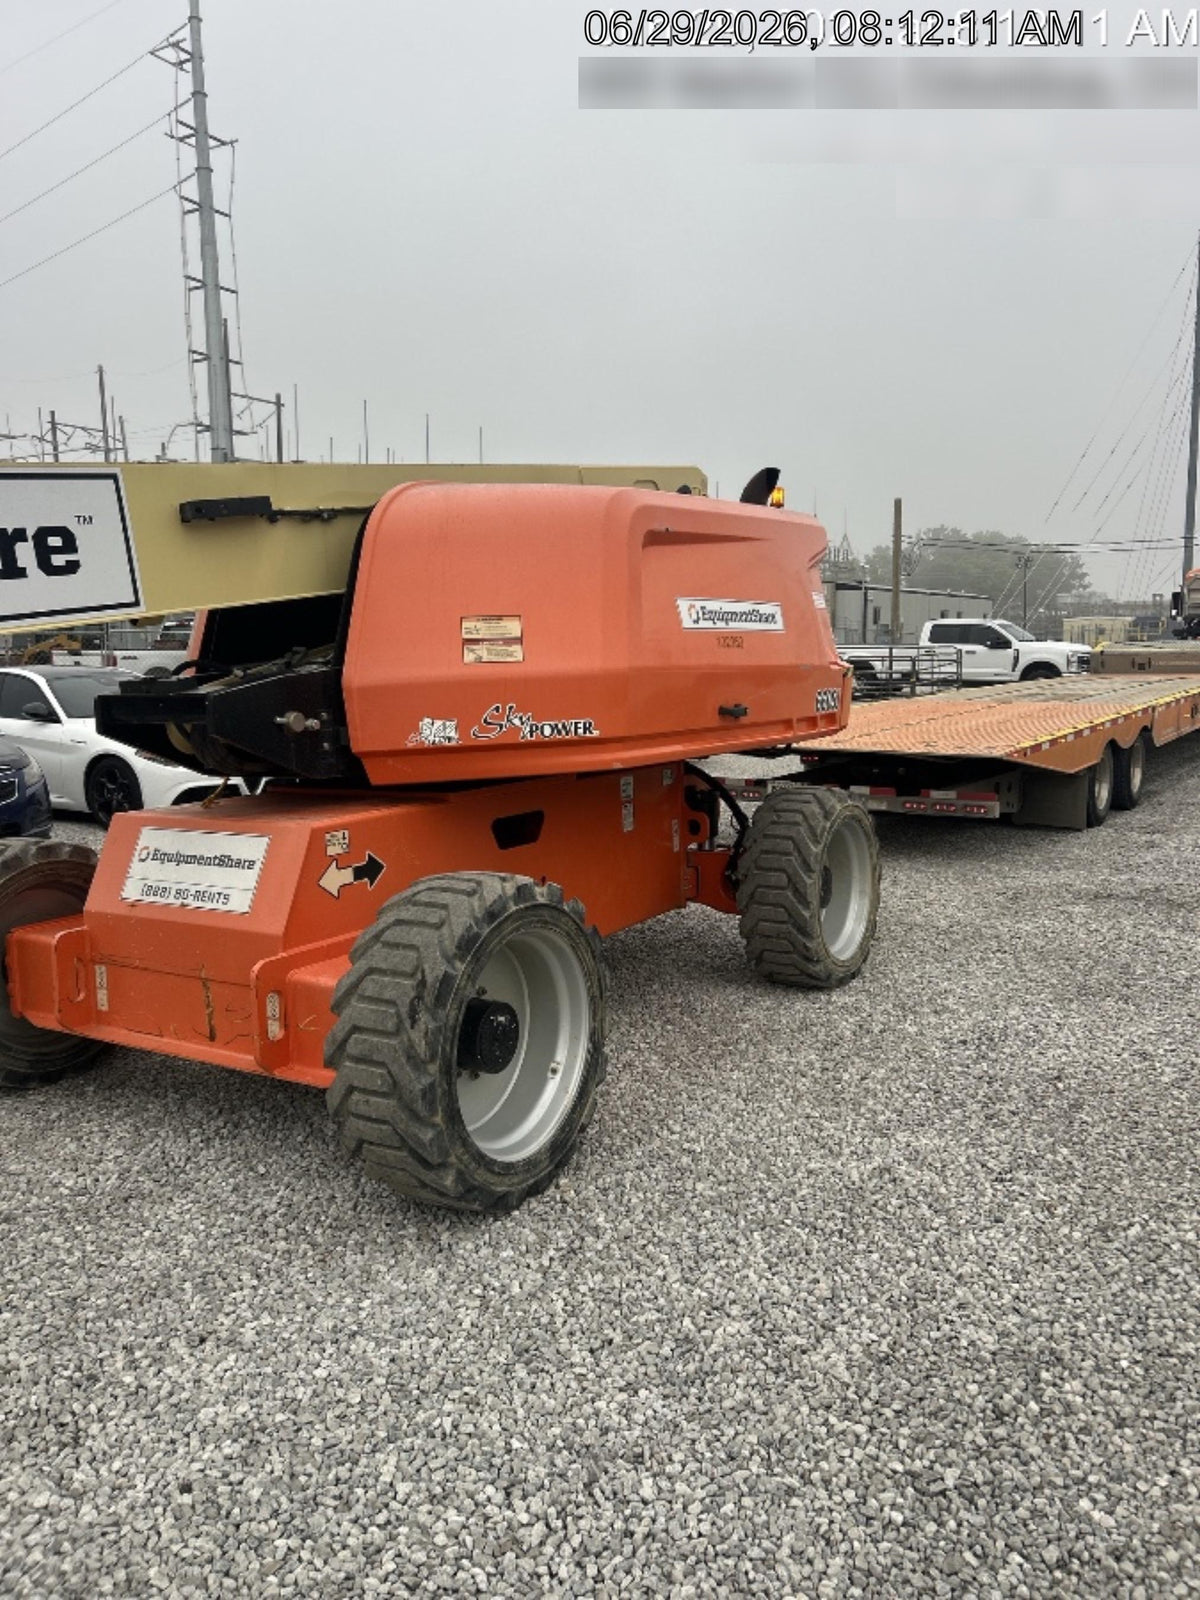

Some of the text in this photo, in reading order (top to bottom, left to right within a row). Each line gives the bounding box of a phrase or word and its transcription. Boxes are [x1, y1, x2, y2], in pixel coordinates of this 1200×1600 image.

[471, 704, 532, 740] Sky
[527, 719, 594, 739] POWER
[150, 848, 257, 870] EquipmentShare
